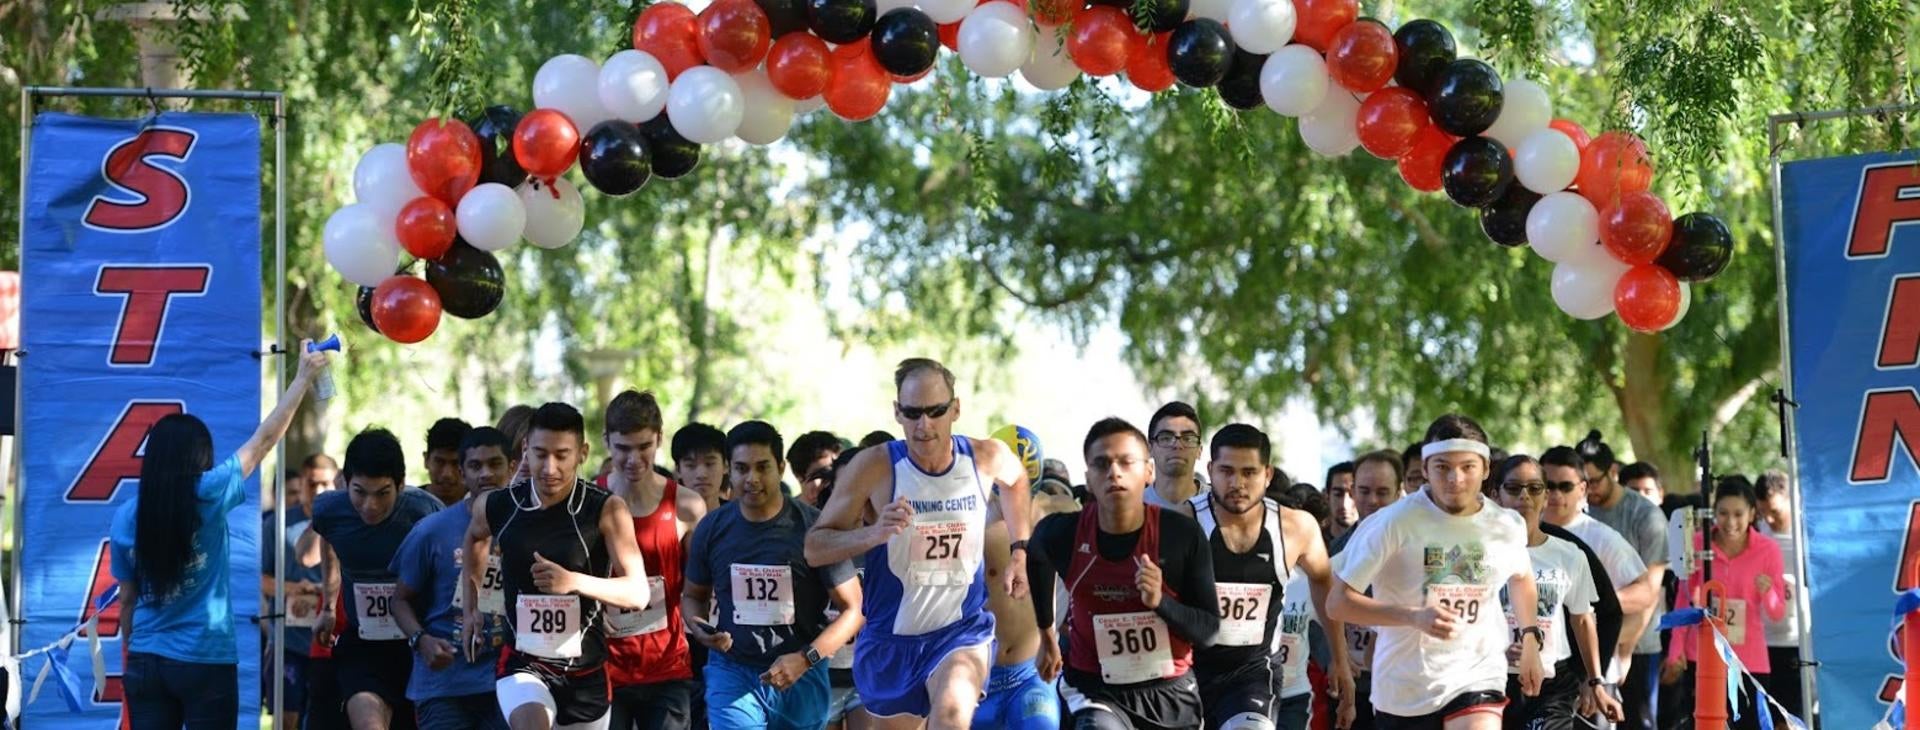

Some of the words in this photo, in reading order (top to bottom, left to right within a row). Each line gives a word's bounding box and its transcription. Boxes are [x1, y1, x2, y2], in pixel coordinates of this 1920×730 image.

[908, 499, 943, 514] UNNING
[944, 494, 977, 512] CENTER
[926, 533, 962, 560] 257
[745, 577, 779, 601] 132
[1219, 596, 1259, 620] 362
[530, 608, 566, 633] 289
[1108, 626, 1157, 656] 360
